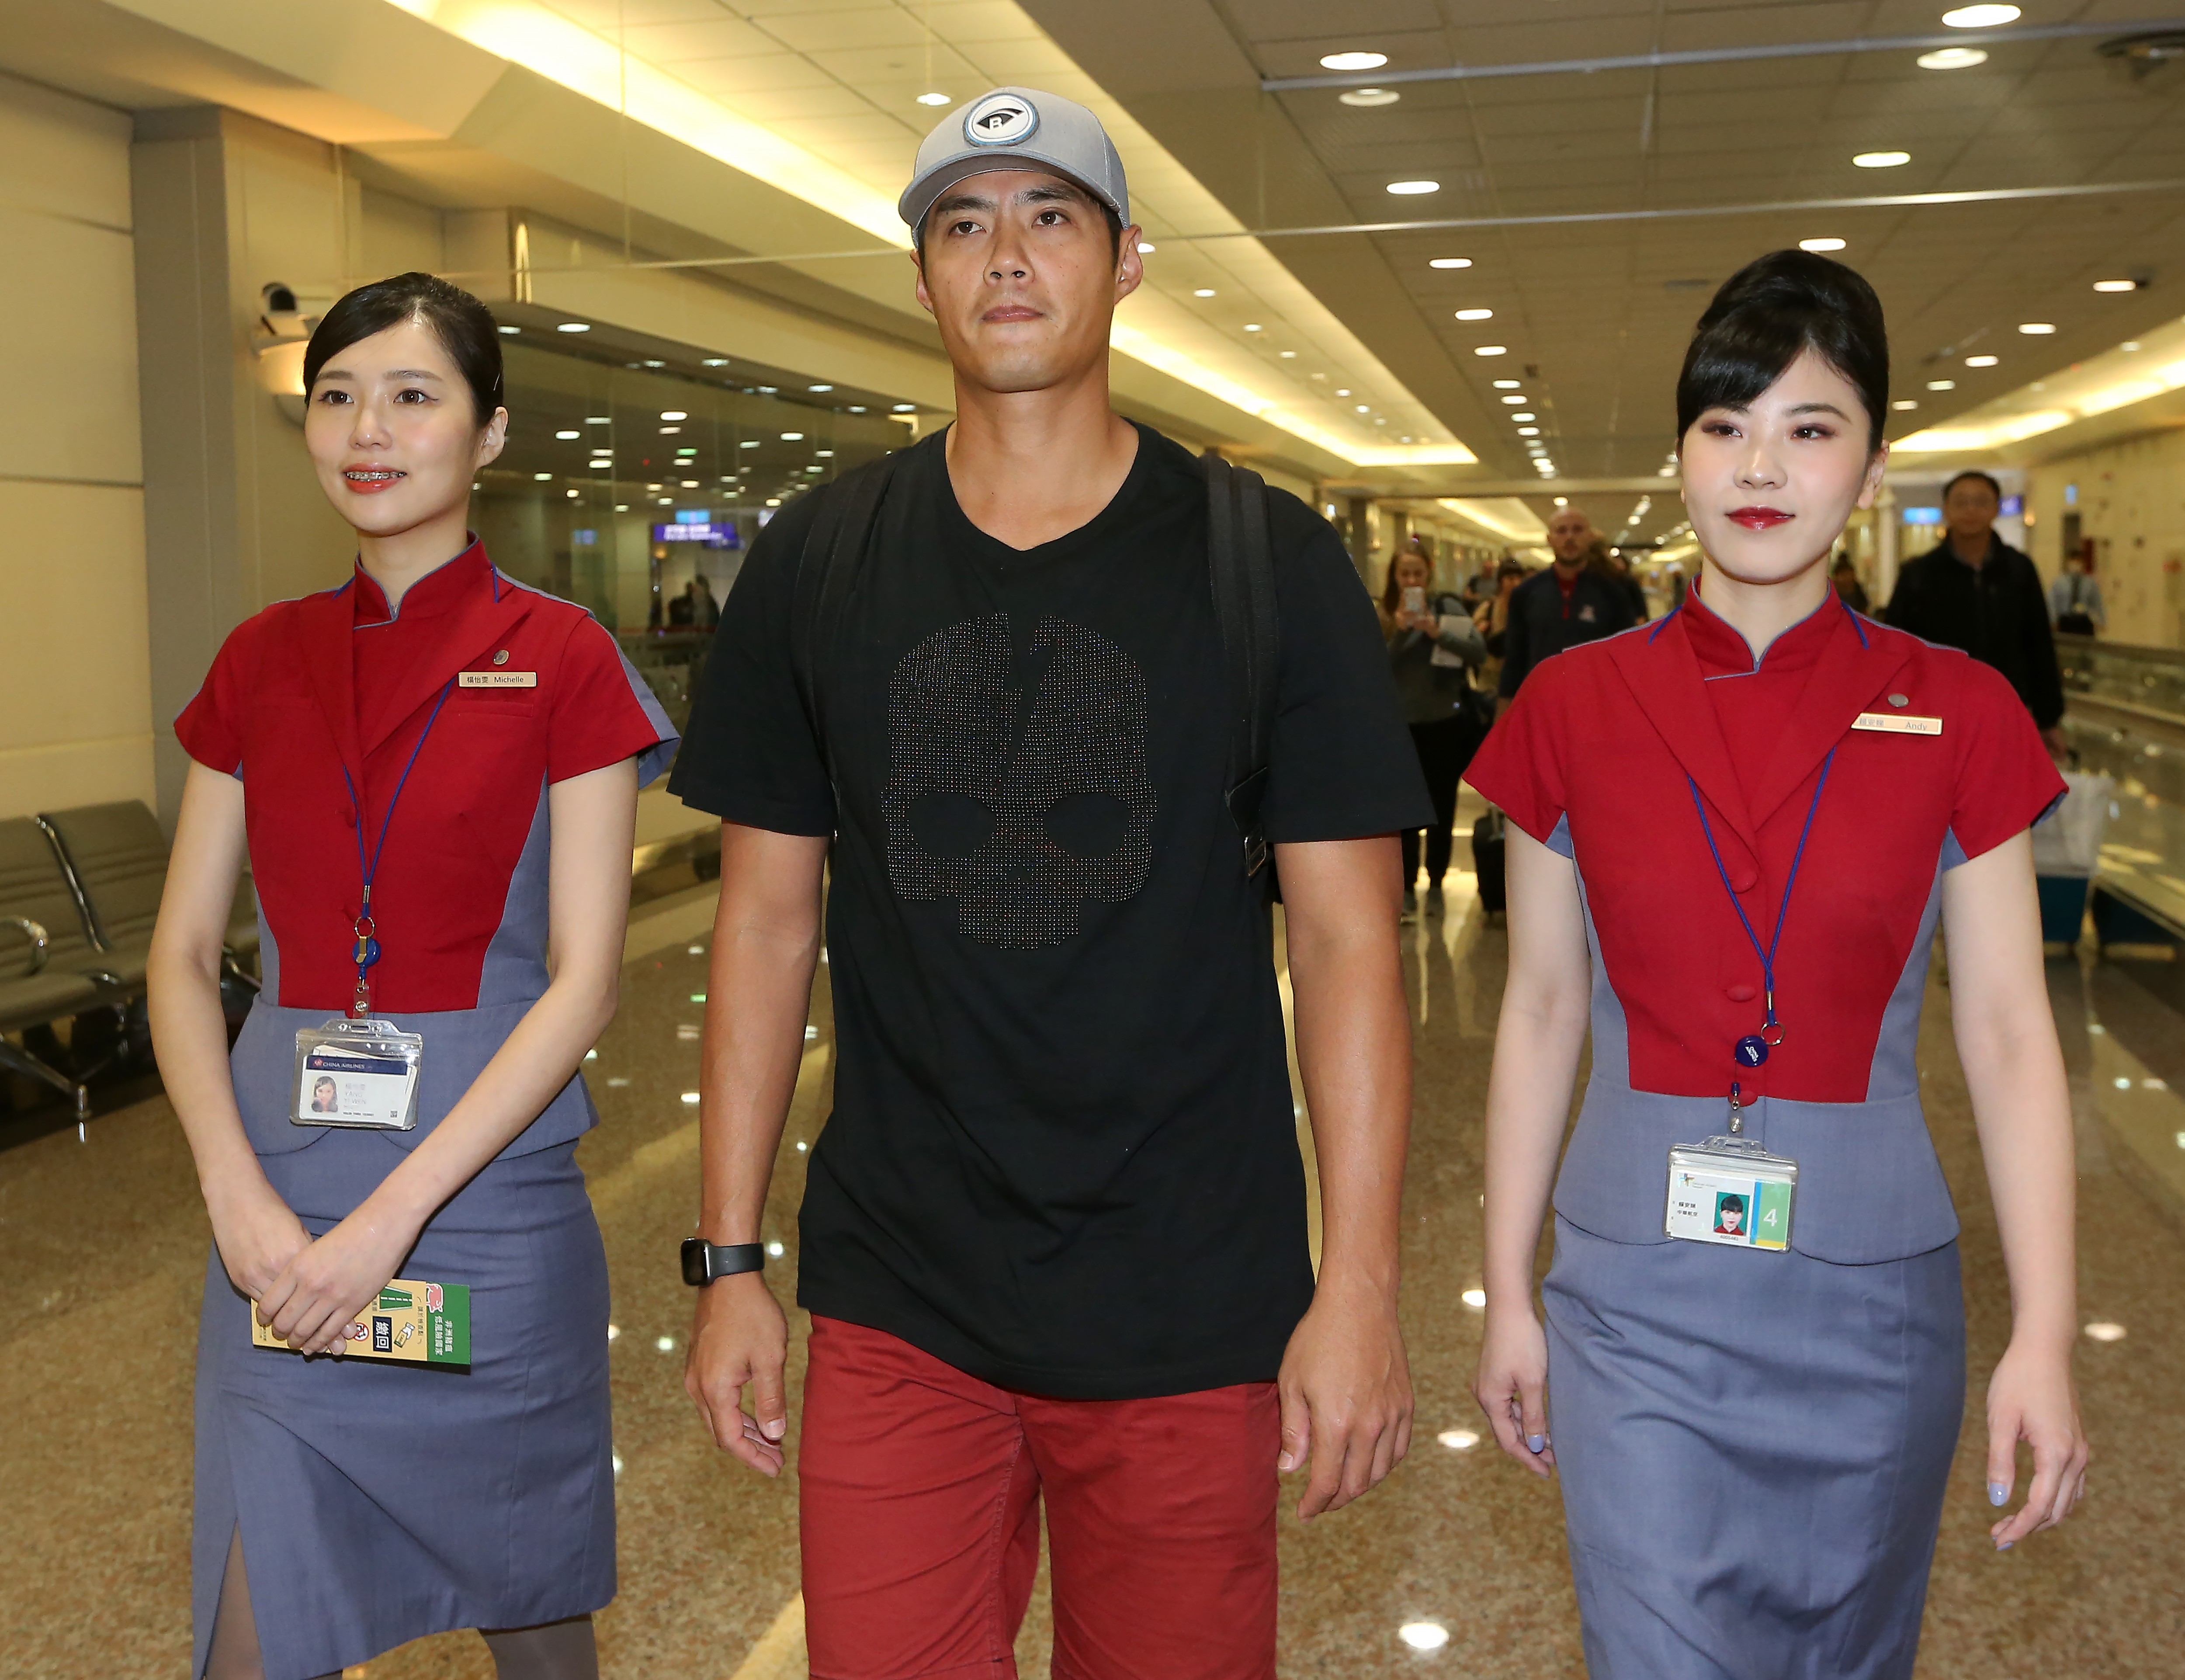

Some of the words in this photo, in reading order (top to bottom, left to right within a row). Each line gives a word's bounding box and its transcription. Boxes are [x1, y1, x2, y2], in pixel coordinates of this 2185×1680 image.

[989, 115, 1003, 130] B
[1905, 721, 1927, 730] Andy
[1762, 1209, 1777, 1227] 4
